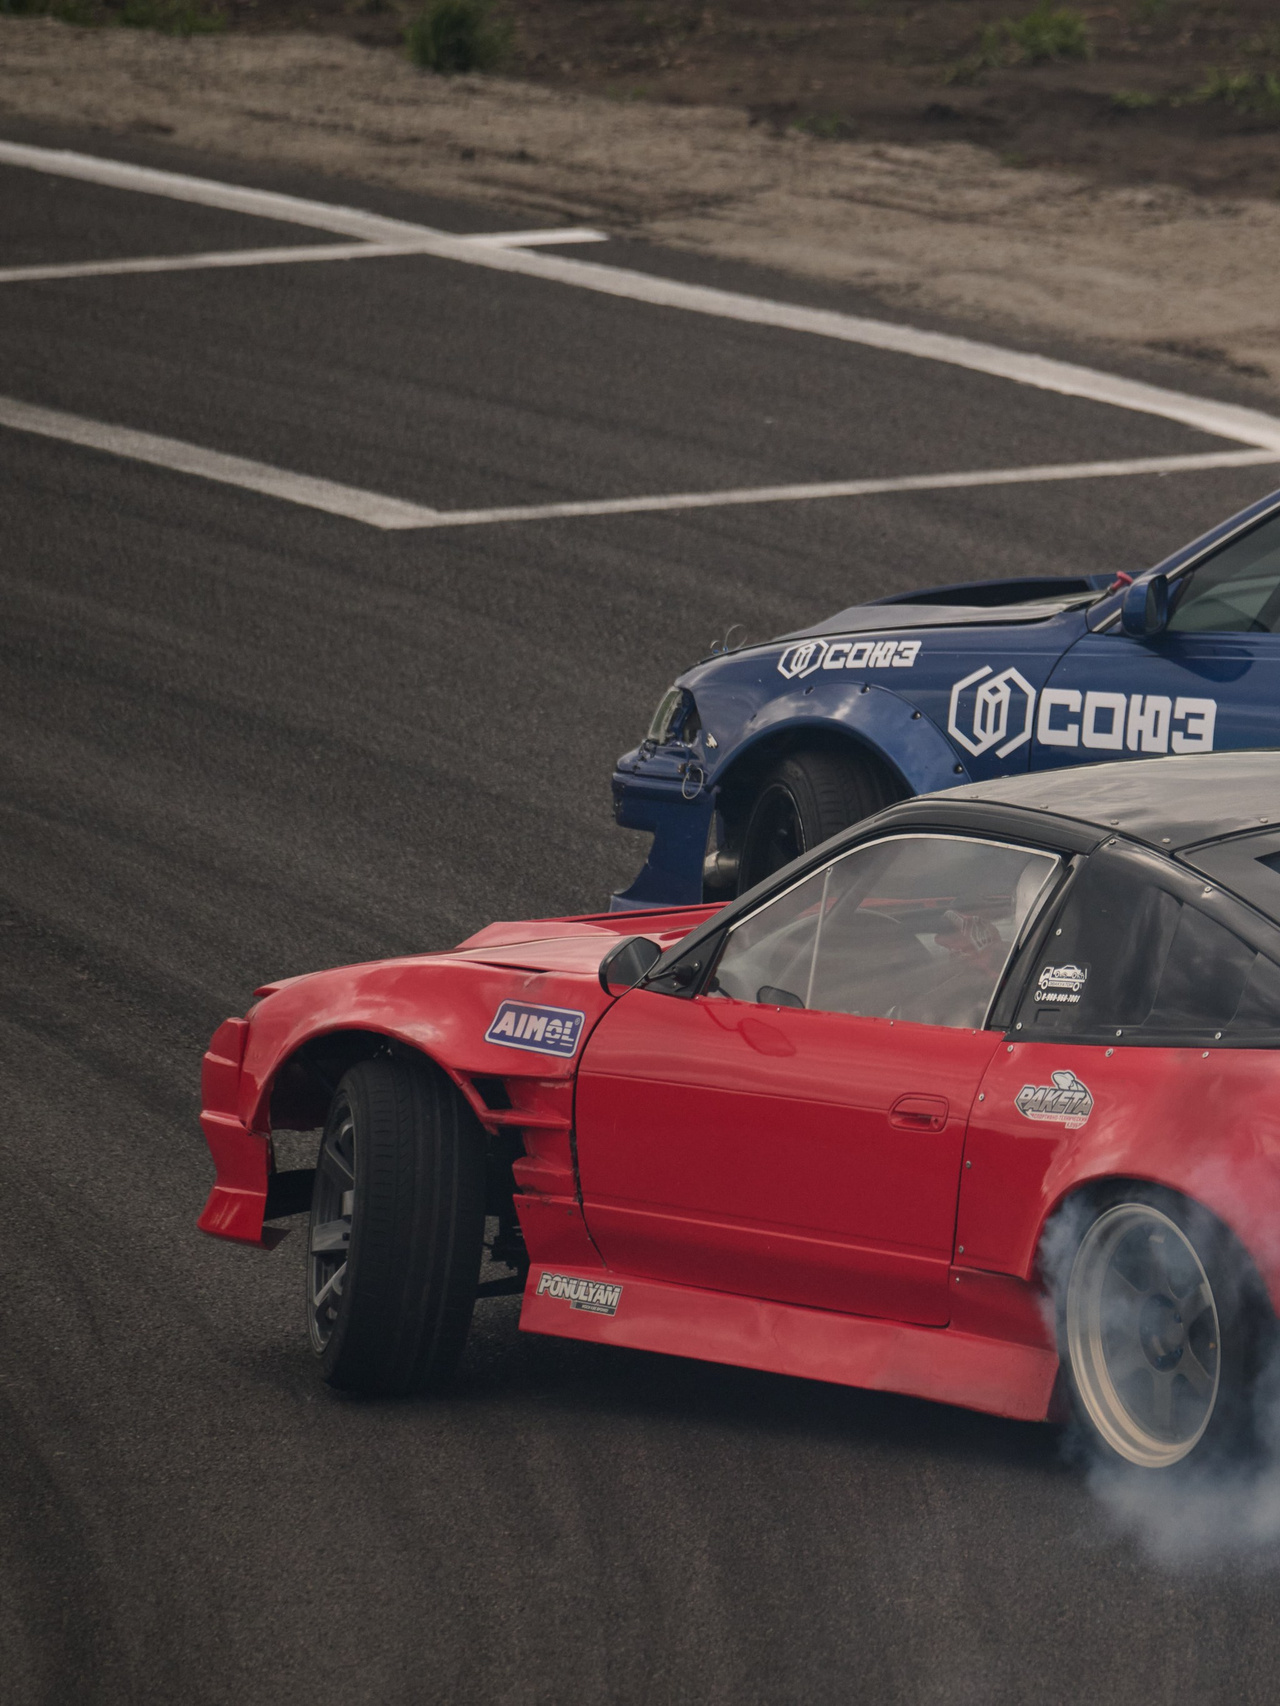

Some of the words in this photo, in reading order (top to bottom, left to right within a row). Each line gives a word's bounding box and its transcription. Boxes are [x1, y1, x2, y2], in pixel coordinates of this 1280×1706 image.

[822, 640, 922, 670] СОЮЗ
[1036, 687, 1217, 754] СОЮЗ
[492, 1010, 574, 1047] AIMOL
[537, 1272, 622, 1307] PONULYAM
